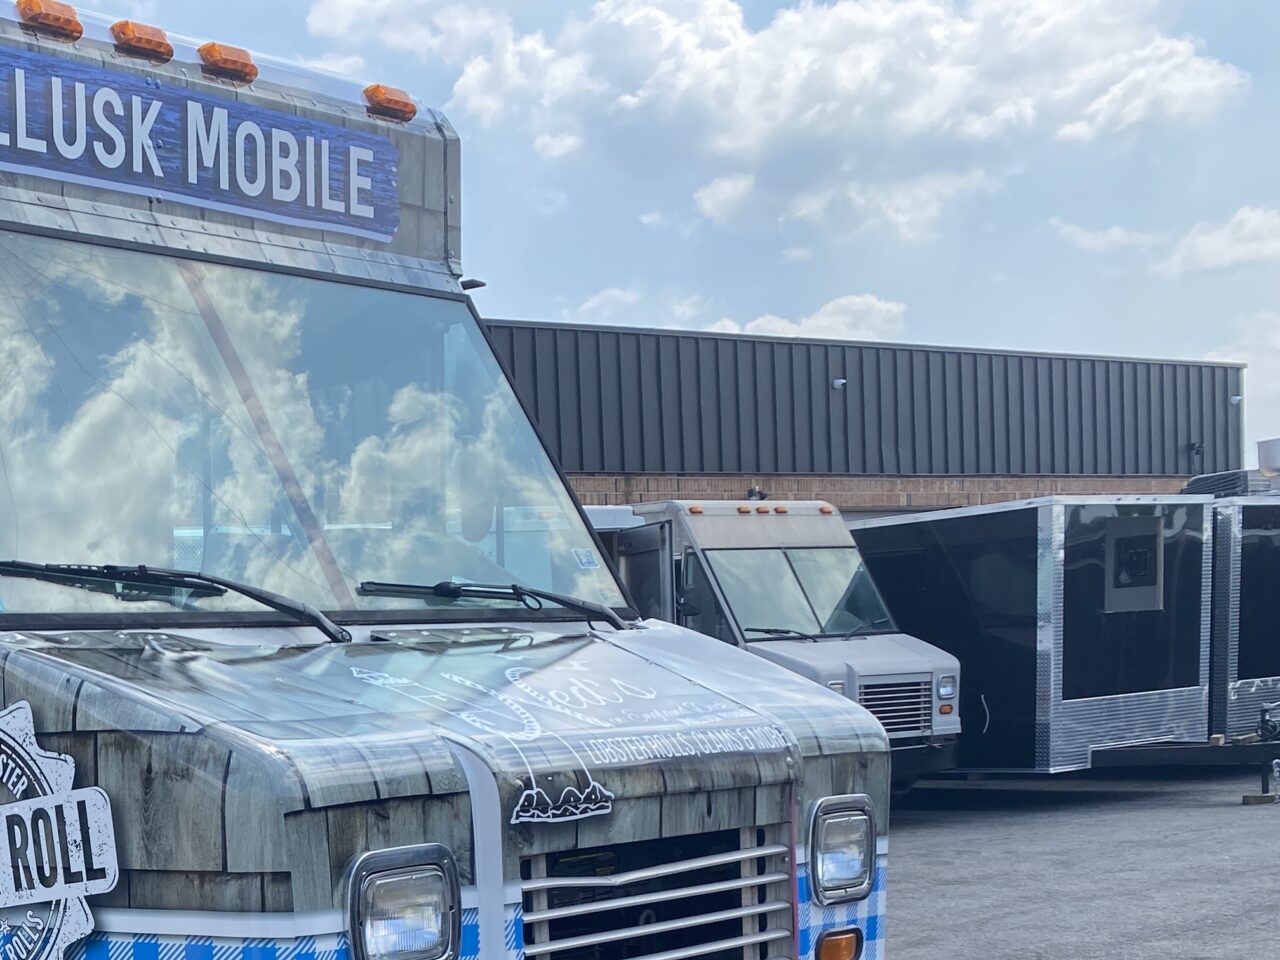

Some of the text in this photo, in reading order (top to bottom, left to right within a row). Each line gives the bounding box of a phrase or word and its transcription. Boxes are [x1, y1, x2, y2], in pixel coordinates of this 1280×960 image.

[187, 99, 374, 219] MOBILE
[581, 736, 654, 764] LOBSTER
[693, 728, 744, 753] CLAMS
[4, 800, 107, 895] ROLL
